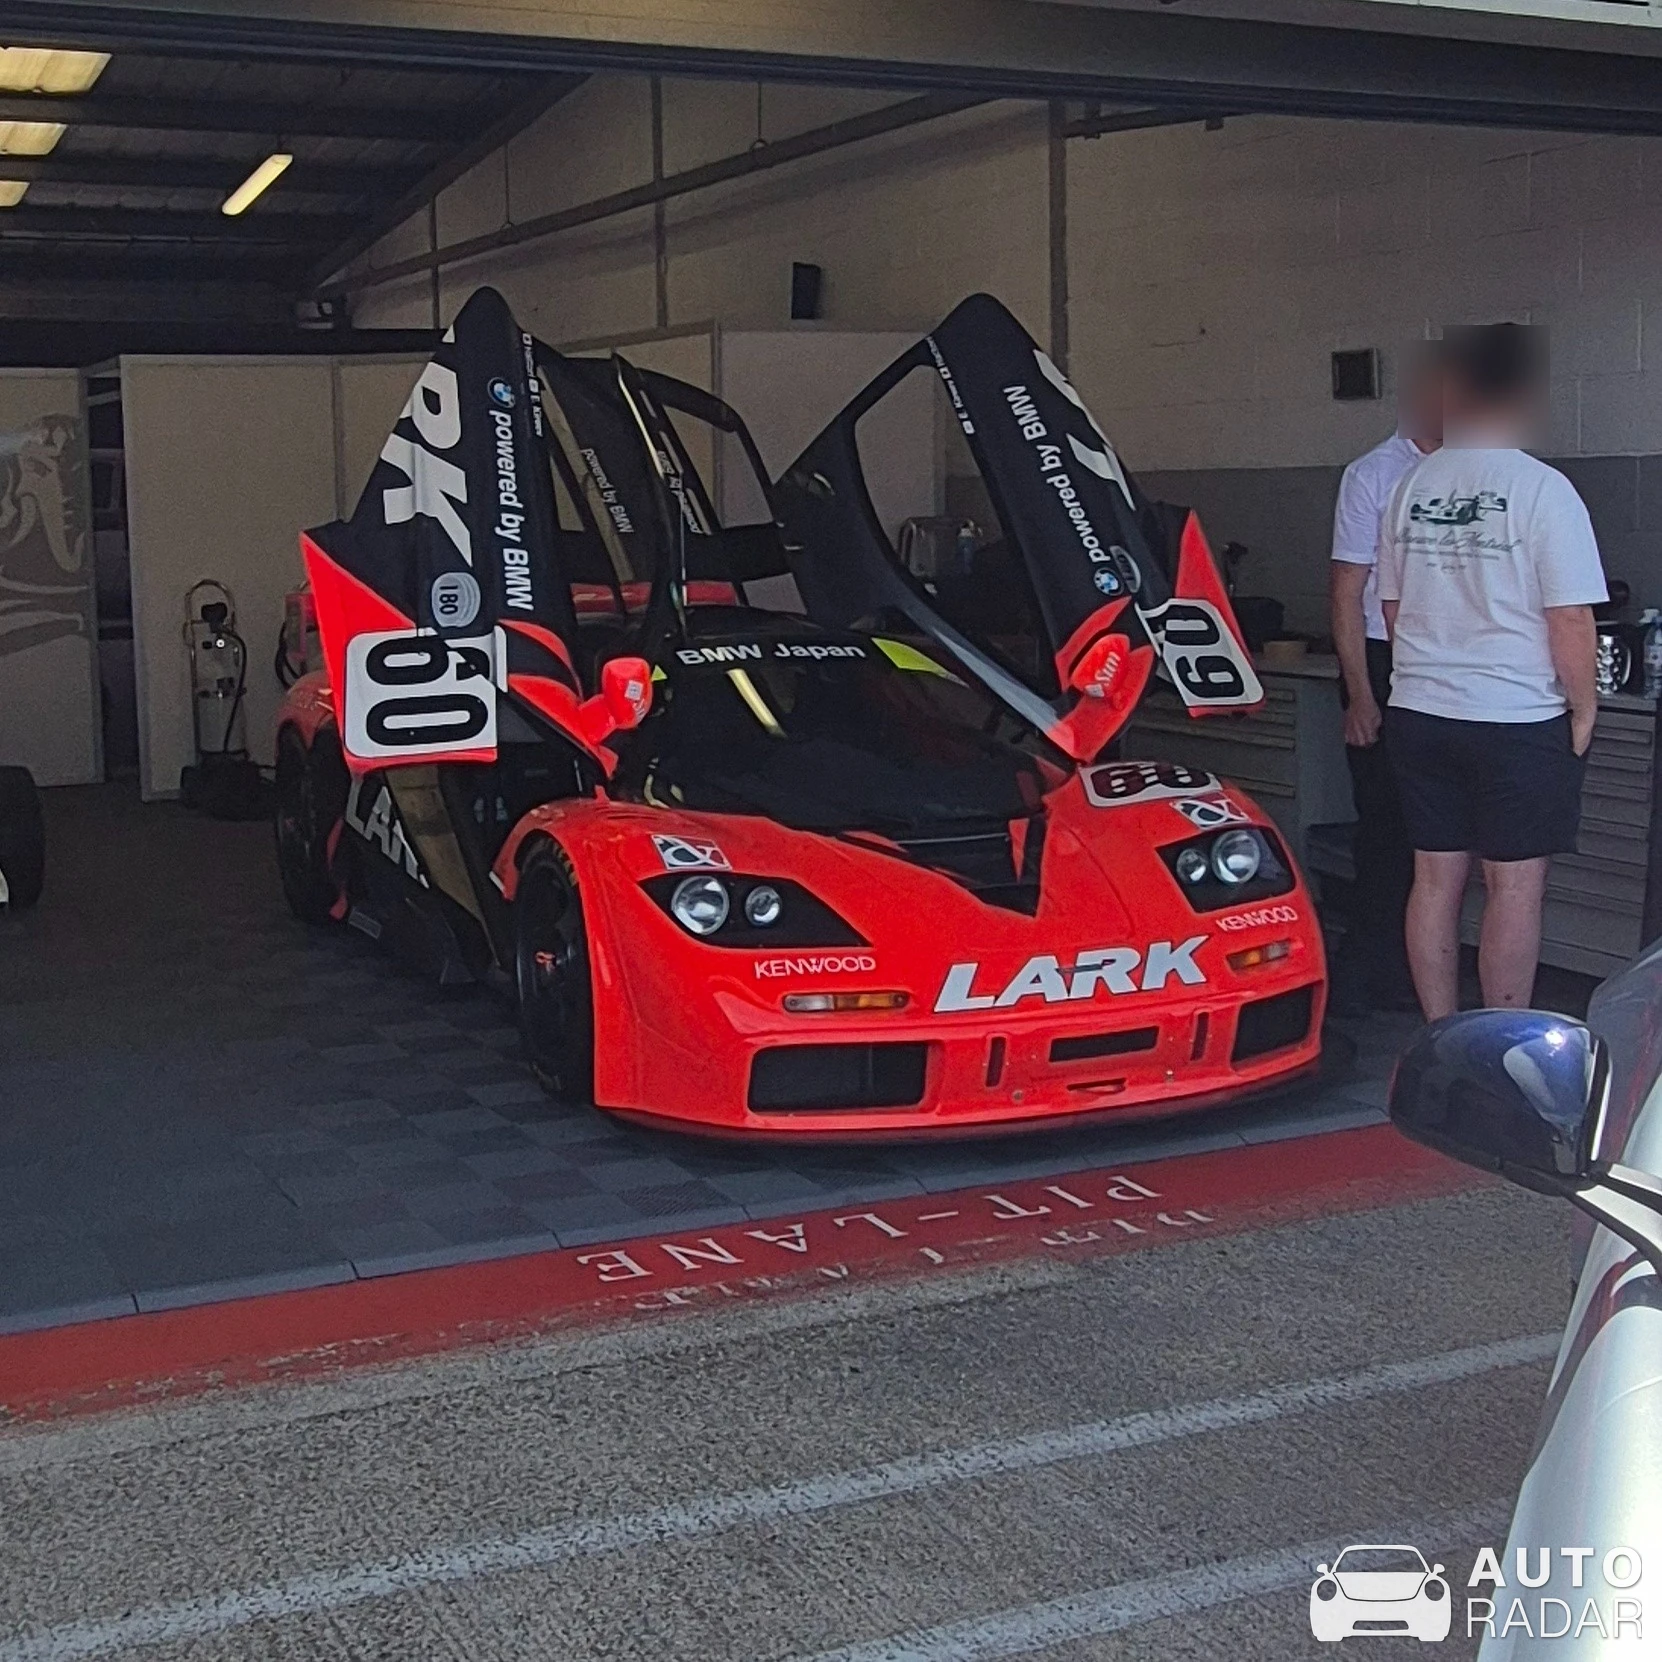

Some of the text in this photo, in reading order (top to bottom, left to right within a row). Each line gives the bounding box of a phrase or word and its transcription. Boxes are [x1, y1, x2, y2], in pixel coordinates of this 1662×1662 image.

[1003, 385, 1048, 441] BMW
[580, 447, 635, 533] powered by BMW
[1036, 444, 1062, 472] by
[489, 409, 534, 611] powered by BMW
[1047, 474, 1111, 563] powered
[366, 632, 491, 747] 60
[676, 643, 867, 665] BMW Japan
[345, 772, 430, 889] LA
[1215, 905, 1298, 932] KENWOOD
[754, 956, 876, 980] KENWOOD
[934, 935, 1210, 1013] LARK
